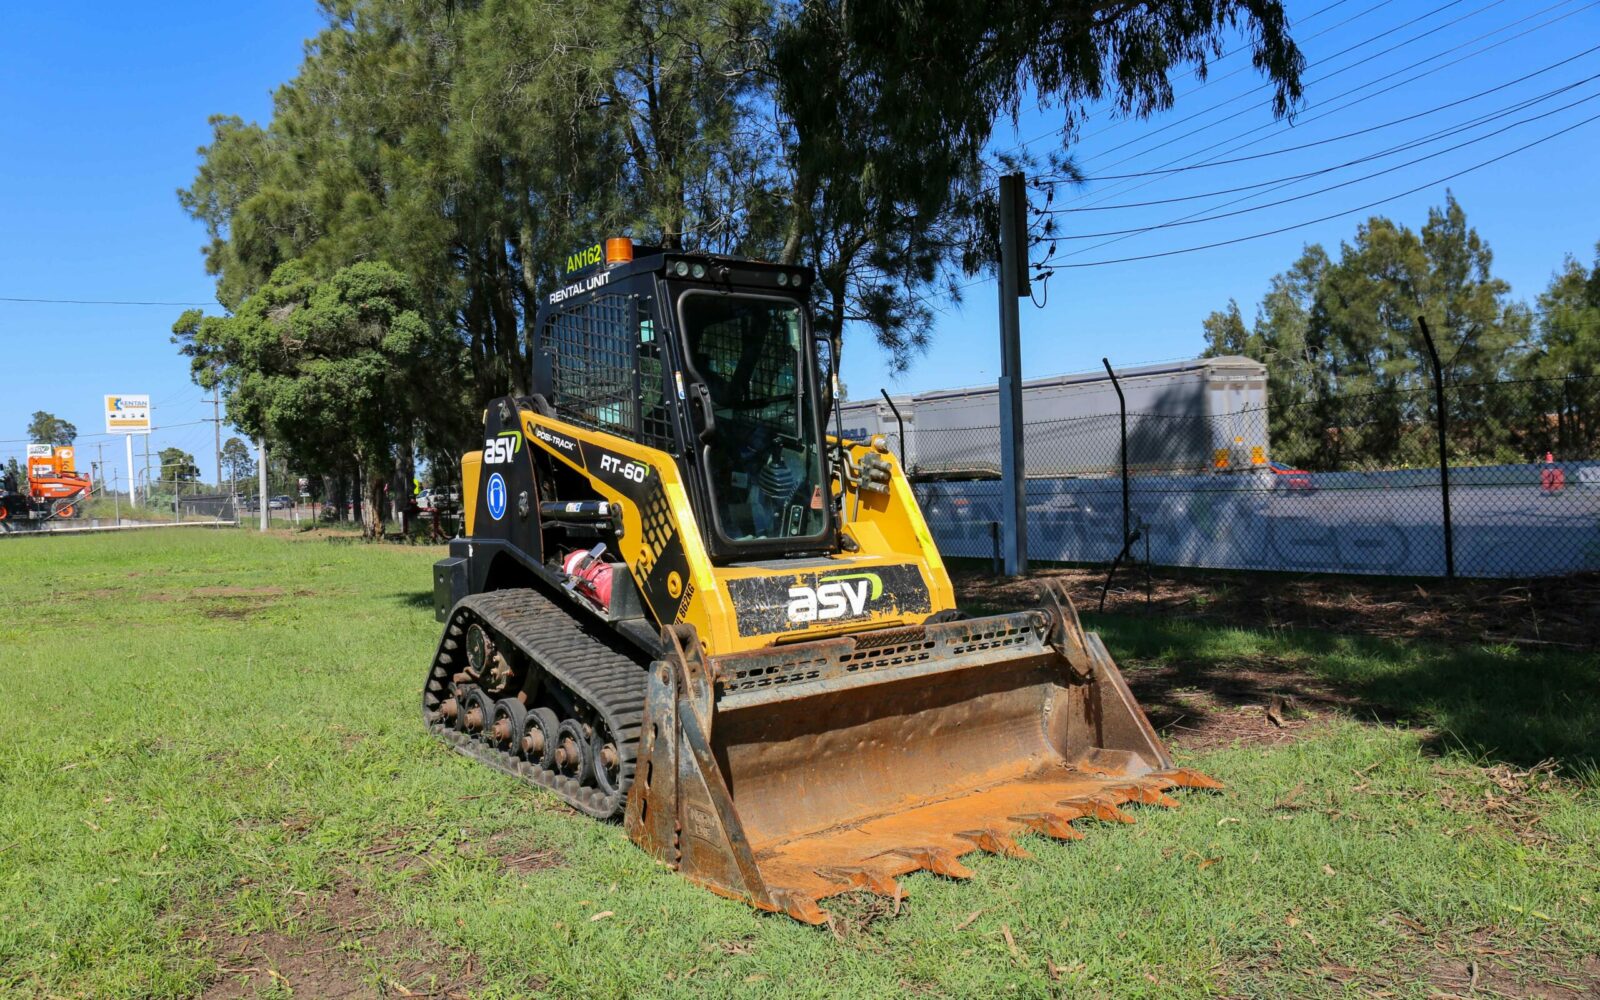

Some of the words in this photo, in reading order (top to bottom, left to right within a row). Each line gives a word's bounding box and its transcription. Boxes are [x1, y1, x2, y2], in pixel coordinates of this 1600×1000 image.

[566, 244, 601, 274] AN162
[549, 282, 585, 305] RENTAL
[586, 271, 611, 290] UNIT
[600, 454, 645, 484] RT-60
[679, 583, 695, 618] 862KG
